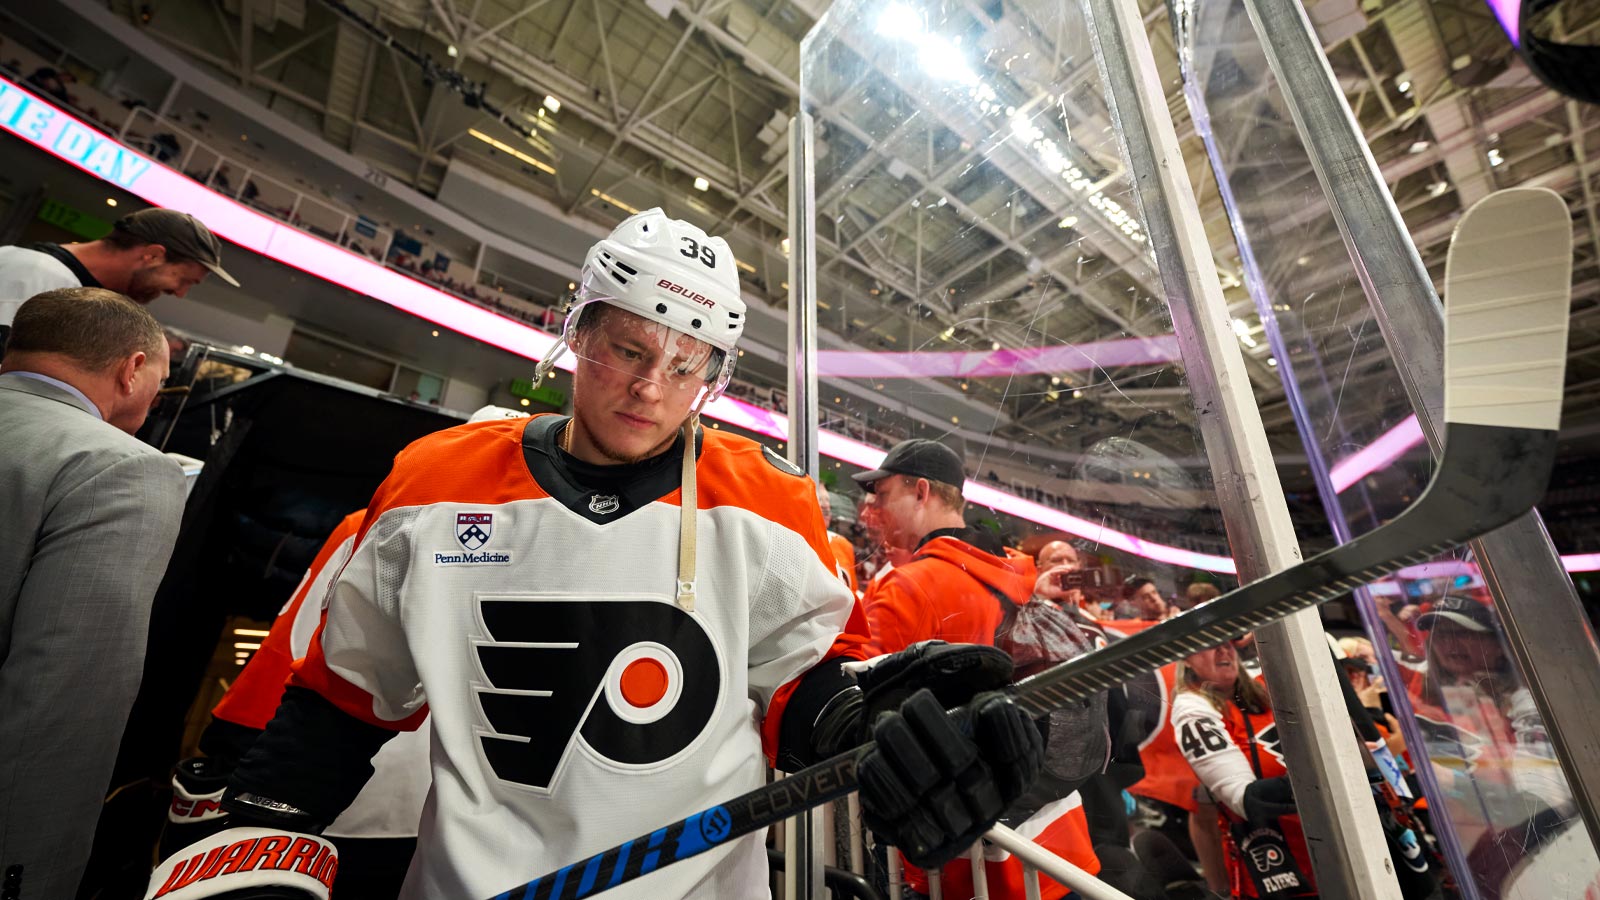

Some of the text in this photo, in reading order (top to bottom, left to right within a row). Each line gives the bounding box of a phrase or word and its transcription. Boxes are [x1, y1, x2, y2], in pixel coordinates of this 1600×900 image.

[53, 119, 151, 189] DAY
[680, 236, 716, 269] 39
[435, 552, 510, 564] Penn Medicine
[1181, 718, 1228, 758] 46
[1262, 872, 1300, 893] FLYERS
